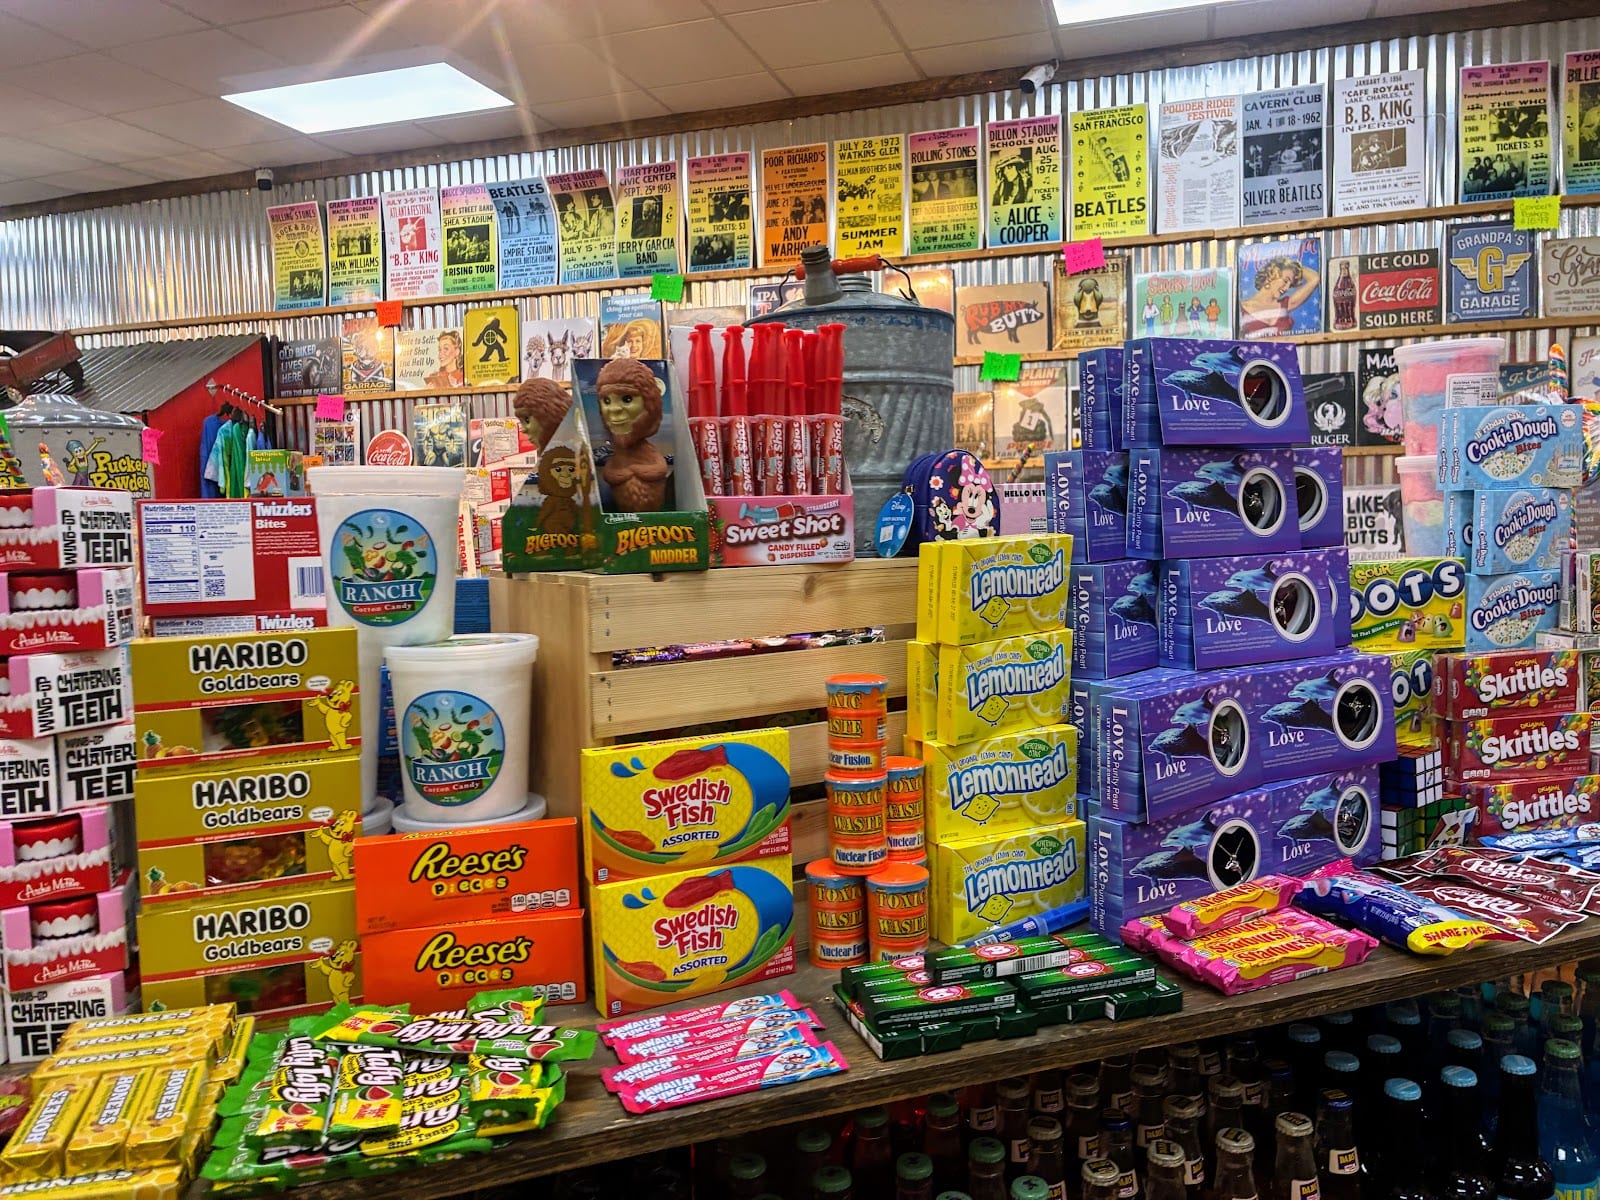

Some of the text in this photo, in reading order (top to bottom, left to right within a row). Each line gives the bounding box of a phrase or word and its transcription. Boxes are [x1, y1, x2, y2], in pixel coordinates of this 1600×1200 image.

[1163, 98, 1235, 115] POWDER RIDGE
[1245, 93, 1322, 112] CAVERN CLUB
[1380, 98, 1412, 119] KING
[1073, 116, 1143, 132] SAN FRANCISCO
[1187, 109, 1233, 122] FESTIVAL
[989, 123, 1058, 142] DILLON STADIUM
[1245, 120, 1261, 131] JAN.
[1357, 118, 1415, 132] PERSON
[839, 141, 859, 152] JULY
[990, 135, 1057, 149] SCHOOLS OUT
[1035, 145, 1059, 155] AUG.
[1496, 143, 1530, 152] TICKETS:
[764, 151, 826, 168] POOR RICHARD'S
[839, 144, 900, 159] WATKINS GLEN
[911, 145, 977, 164] ROLLING STONES
[1039, 155, 1053, 164] 25
[623, 164, 671, 178] HARTFORD
[1035, 163, 1058, 174] 1972
[619, 172, 676, 186] CIVIC CENTER
[657, 183, 672, 193] 1993
[489, 183, 545, 199] BEATLES
[1243, 188, 1276, 207] SILVER
[1279, 183, 1322, 203] BEATLES
[350, 198, 378, 207] THEATER
[1074, 197, 1146, 218] BEATLES
[271, 209, 316, 223] ROLLING STONES
[463, 215, 493, 224] STADIUM
[1008, 206, 1041, 226] ALICE
[783, 226, 809, 240] ANDY
[841, 227, 897, 241] SUMMER
[941, 233, 965, 242] PALACE
[1000, 226, 1049, 245] COOPER
[1456, 232, 1524, 250] GRANDPA'S
[503, 247, 526, 257] EMPIRE
[563, 245, 583, 254] JULY
[618, 238, 675, 253] JERRY GARCIA
[856, 239, 883, 250] JAM
[932, 241, 972, 250] FRANCISCO
[349, 256, 379, 268] WILLIAMS
[419, 249, 439, 264] KING
[636, 252, 658, 265] BAND
[1367, 253, 1430, 270] ICE COLD
[448, 266, 473, 276] RISING
[475, 264, 495, 274] TOUR
[1361, 278, 1432, 305] Coca-Cola
[1460, 294, 1521, 310] GARAGE
[1365, 310, 1434, 328] SOLD HERE
[279, 348, 294, 359] OLD
[280, 360, 303, 371] LIVES
[399, 368, 425, 378] Already
[281, 372, 302, 384] HERE
[1171, 395, 1211, 412] Love
[1311, 433, 1350, 445] RUGER
[93, 451, 148, 474] Pucker
[705, 423, 722, 494] Sweet Shot
[772, 421, 783, 492] Sweet Shot
[255, 501, 313, 517] Twizzlers
[806, 499, 840, 512] STRAWBERRY
[1346, 496, 1383, 513] LIKE
[79, 510, 132, 530] CHATTERING
[255, 519, 287, 529] Bites
[1175, 508, 1212, 524] Love
[1348, 516, 1376, 528] BIG
[62, 510, 74, 565] WIND-UP
[179, 525, 196, 533] 110
[726, 513, 842, 544] Sweet Shot
[82, 532, 133, 563] TEETH
[615, 524, 698, 556] BIGFOOT
[650, 548, 698, 565] NODDER
[970, 550, 1064, 602] Lemonhead
[1355, 563, 1394, 585] SOUR
[346, 582, 417, 602] RANCH
[353, 602, 413, 613] Cotton Candy
[258, 614, 314, 630] Twizzlers
[191, 641, 306, 671] HARIBO
[57, 667, 122, 692] CHATTERING
[968, 645, 1065, 703] Lemonhead
[201, 674, 299, 693] Goldbears
[1479, 666, 1568, 702] Skittles
[36, 676, 52, 732] WIND-UP
[59, 693, 122, 727] TEETH
[1268, 729, 1305, 748] Love
[1480, 725, 1579, 764] Skittles
[415, 762, 483, 782] RANCH
[949, 743, 1070, 801] Lemonhead
[1155, 758, 1187, 782] Love
[193, 772, 310, 808] HARIBO
[423, 781, 480, 794] Cotton Candy
[641, 779, 731, 818] Swedish
[204, 805, 302, 828] Goldbears
[664, 802, 717, 830] Fish
[1501, 790, 1591, 830] Skittles
[833, 814, 882, 832] WASTE
[661, 830, 720, 849] ASSORTED
[835, 849, 869, 864] Nuclear
[1282, 840, 1312, 863] Love
[409, 842, 527, 884] Reese's
[964, 849, 1078, 901] Lemonhead
[1136, 880, 1177, 904] Love
[1193, 883, 1259, 908] Starburst
[196, 904, 310, 941] HARIBO
[653, 904, 738, 945] Swedish
[879, 920, 928, 935] WASTE
[675, 927, 725, 956] Fish
[1424, 928, 1461, 942] SHARE
[205, 937, 301, 962] Goldbears
[417, 933, 535, 973] Reese's
[820, 944, 853, 958] Nuclear
[1234, 939, 1323, 963] Starburst
[672, 955, 728, 977] ASSORTED
[11, 1000, 106, 1022] CHATTERING
[87, 1010, 193, 1030] HONEES
[670, 1004, 722, 1022] Lemon Berry
[607, 1015, 667, 1038] HAWAIIAN
[693, 1020, 746, 1038] Lemon Berry
[78, 1027, 189, 1047] HONEES
[55, 1045, 172, 1067] HONEES
[355, 1049, 402, 1087] Taffy
[705, 1061, 763, 1083] Lemon Berry
[721, 1069, 759, 1085] Squeeze
[287, 1066, 332, 1105] Taffy
[634, 1074, 702, 1104] HAWAIIAN
